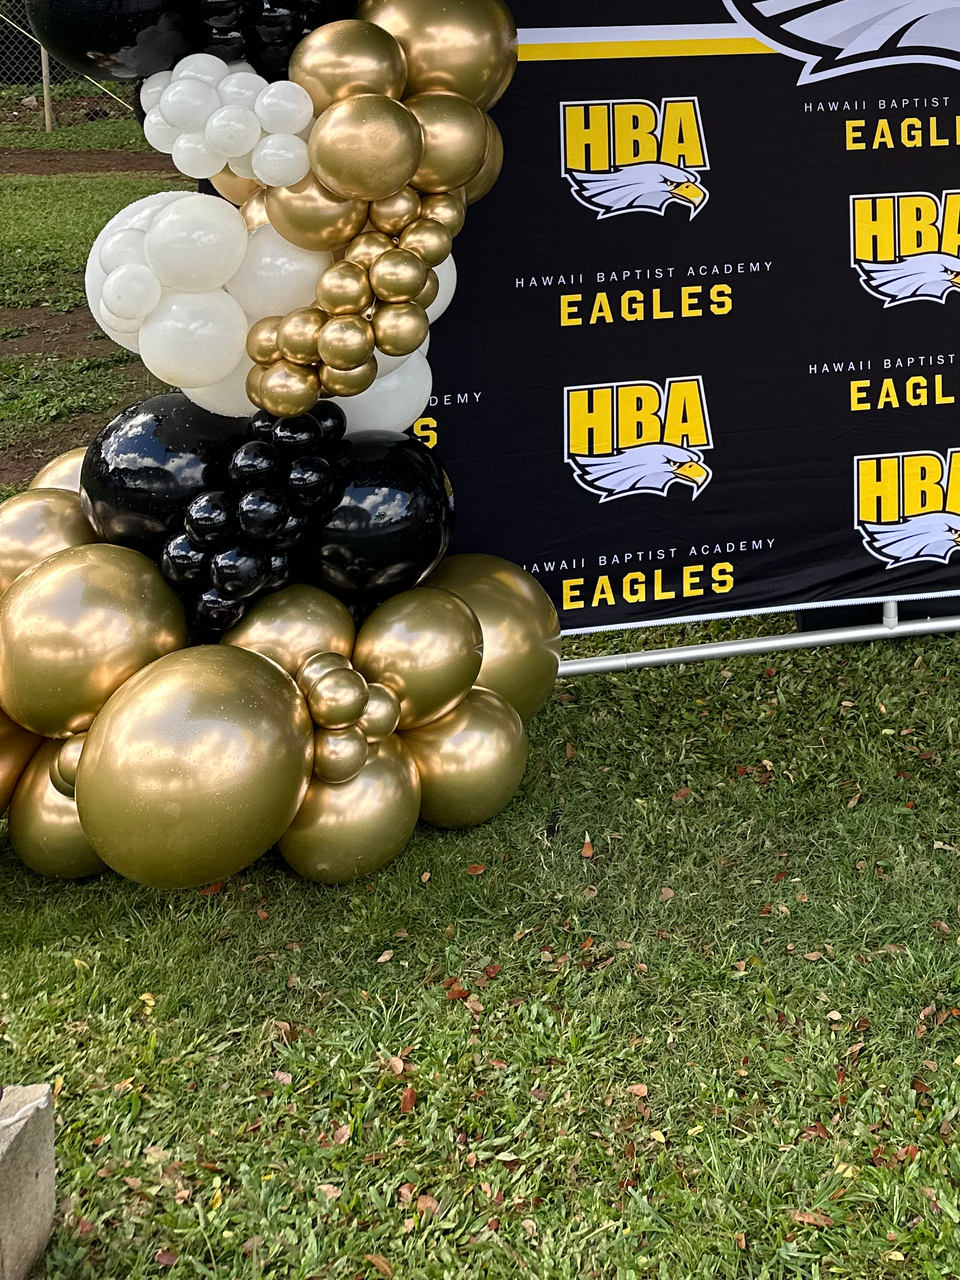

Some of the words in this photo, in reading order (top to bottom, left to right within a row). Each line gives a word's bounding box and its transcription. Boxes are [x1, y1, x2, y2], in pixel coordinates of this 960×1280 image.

[804, 100, 866, 113] HAWAII
[878, 96, 950, 110] BAPTIST
[562, 99, 708, 172] HBA
[515, 273, 583, 288] HAWAII
[596, 267, 675, 283] BAPTIST
[687, 261, 772, 277] ACADEMY
[560, 283, 733, 327] EAGLES
[809, 360, 871, 374] HAWAII
[883, 353, 955, 369] BAPTIST
[429, 391, 482, 407] DEMY
[567, 378, 710, 456] HBA
[598, 548, 677, 566] BAPTIST
[688, 538, 775, 556] ACADEMY
[562, 561, 734, 611] EAGLES
